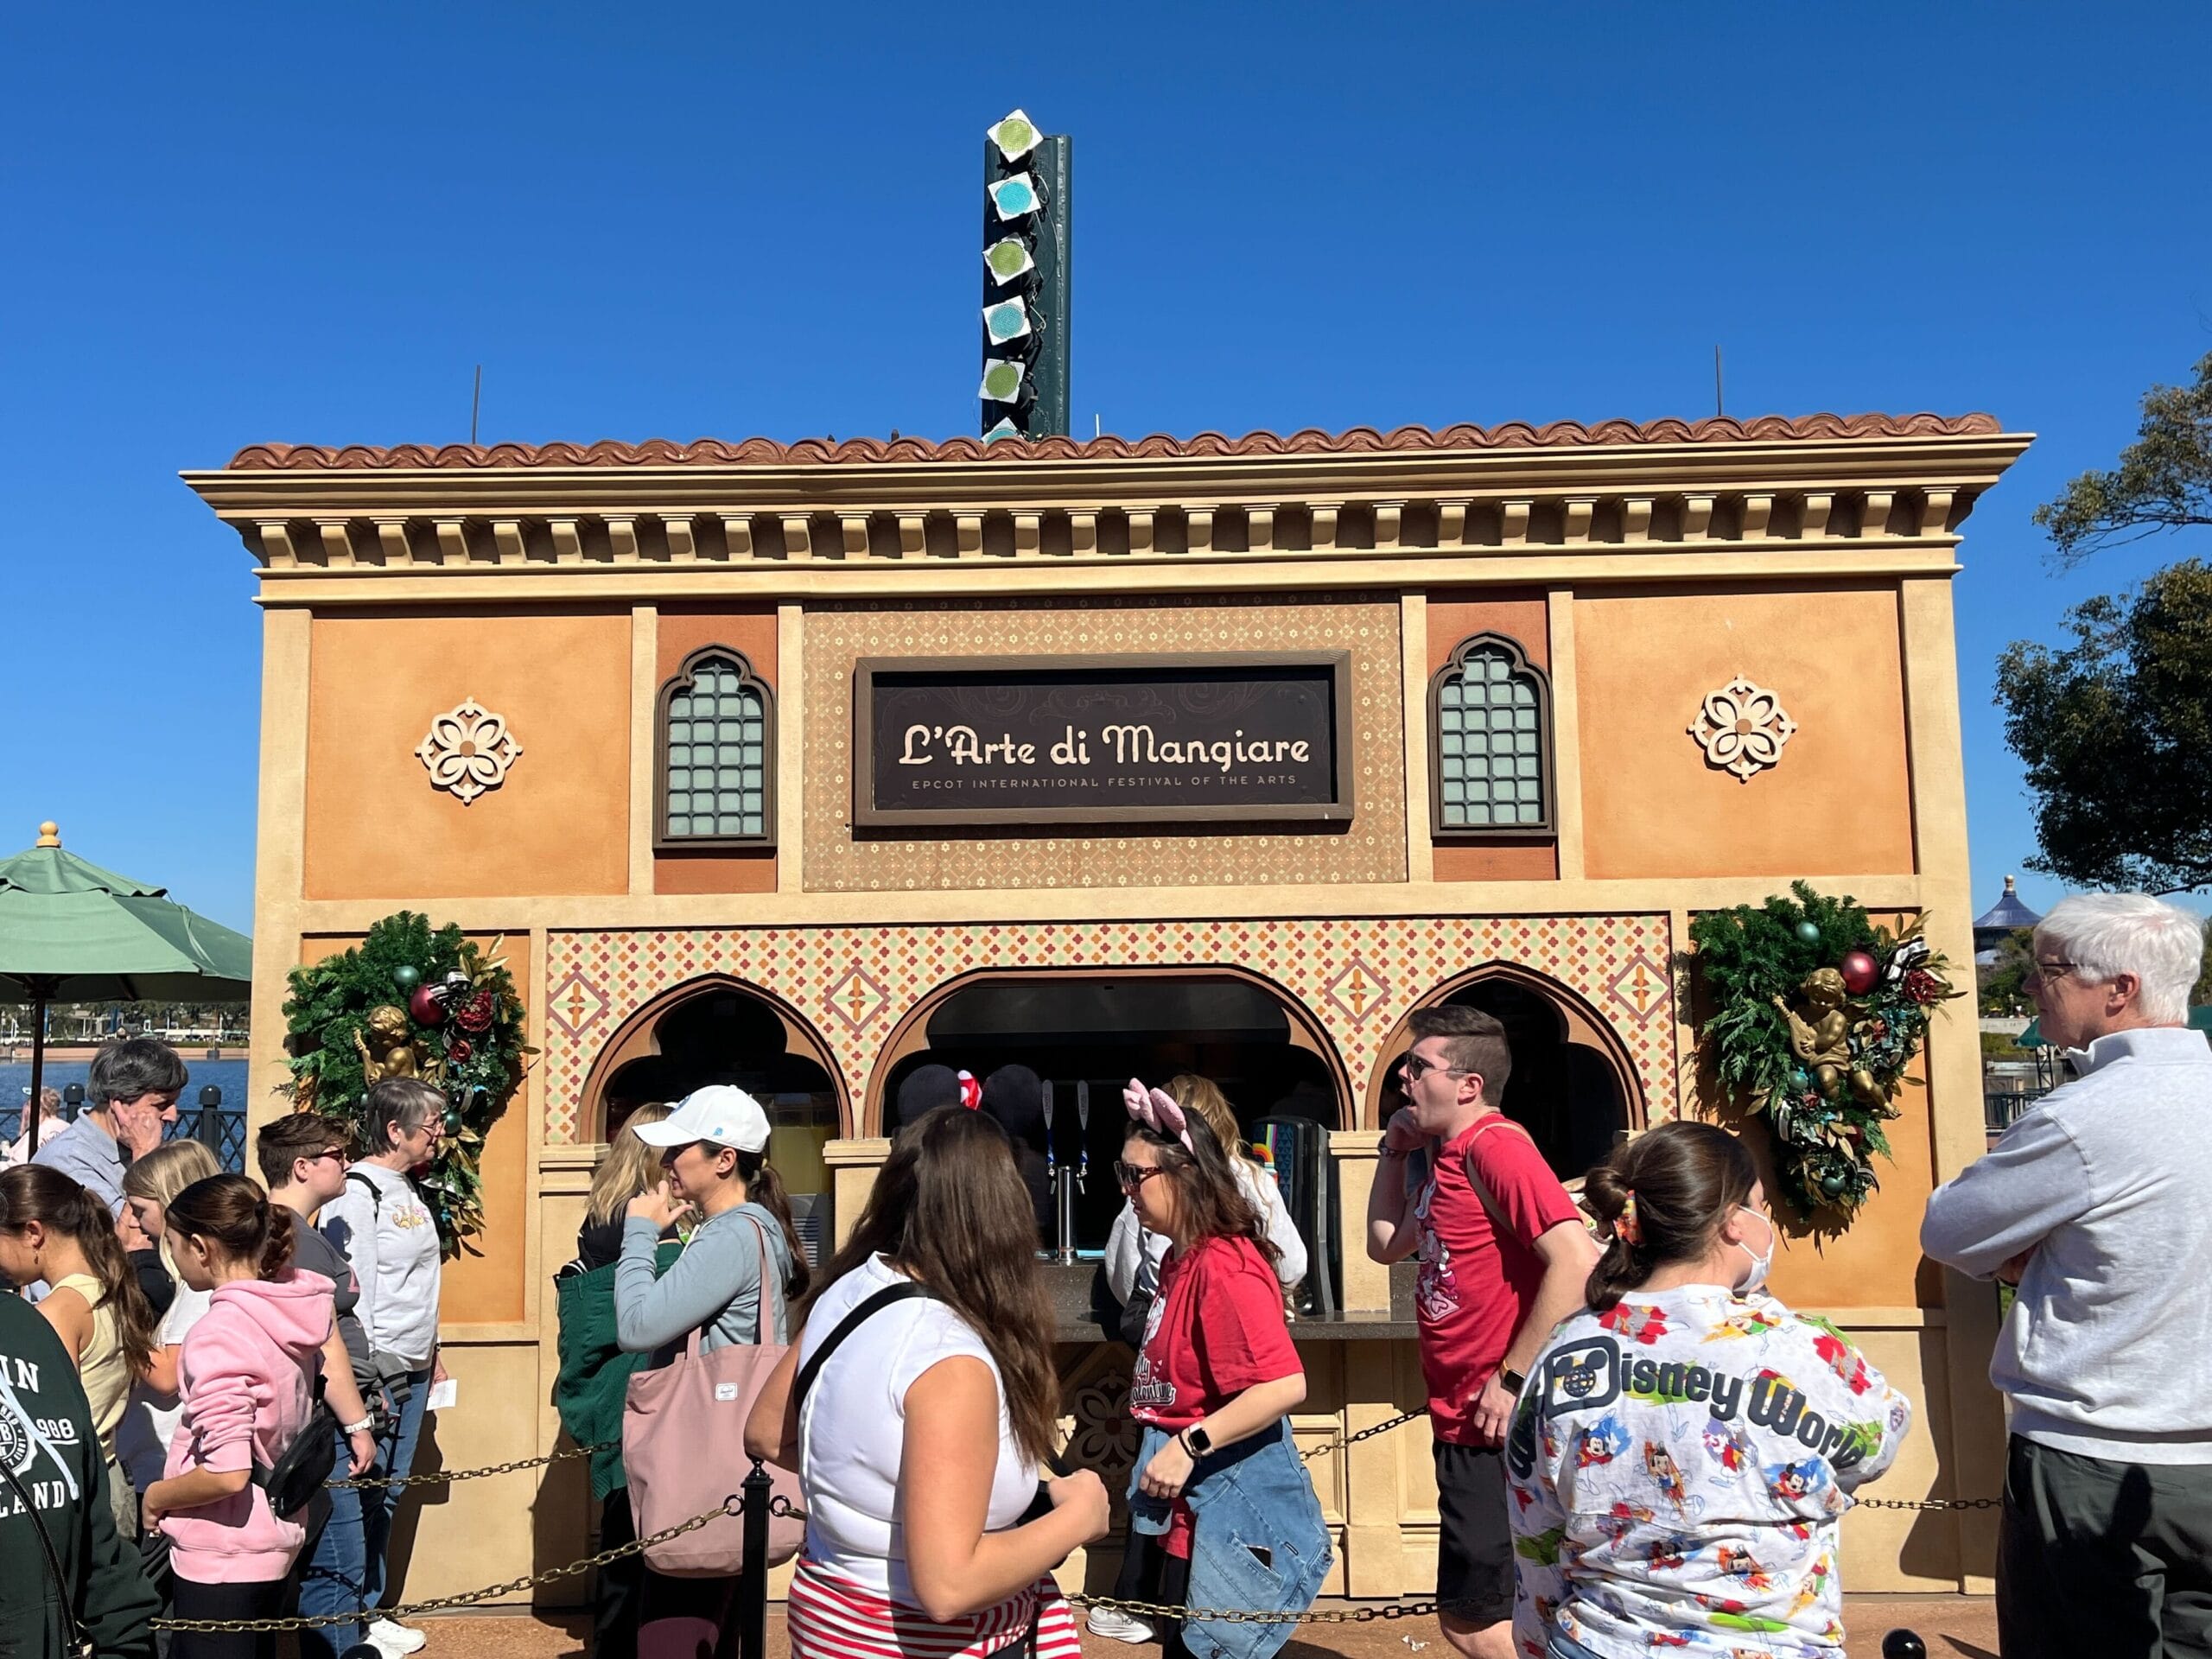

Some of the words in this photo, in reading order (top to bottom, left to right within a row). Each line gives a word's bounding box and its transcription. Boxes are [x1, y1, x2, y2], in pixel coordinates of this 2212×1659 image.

[899, 724, 1036, 765] L'Arte
[1050, 725, 1090, 765] di
[1102, 724, 1310, 772] Mangiare
[912, 779, 963, 790] EPCOT
[972, 778, 1099, 789] INTERNATIONAL
[1108, 777, 1182, 787] FESTIVAL
[1191, 776, 1211, 785] OF
[1219, 775, 1249, 785] THE
[1257, 774, 1297, 785] ARTS
[1132, 1376, 1176, 1405] alentine
